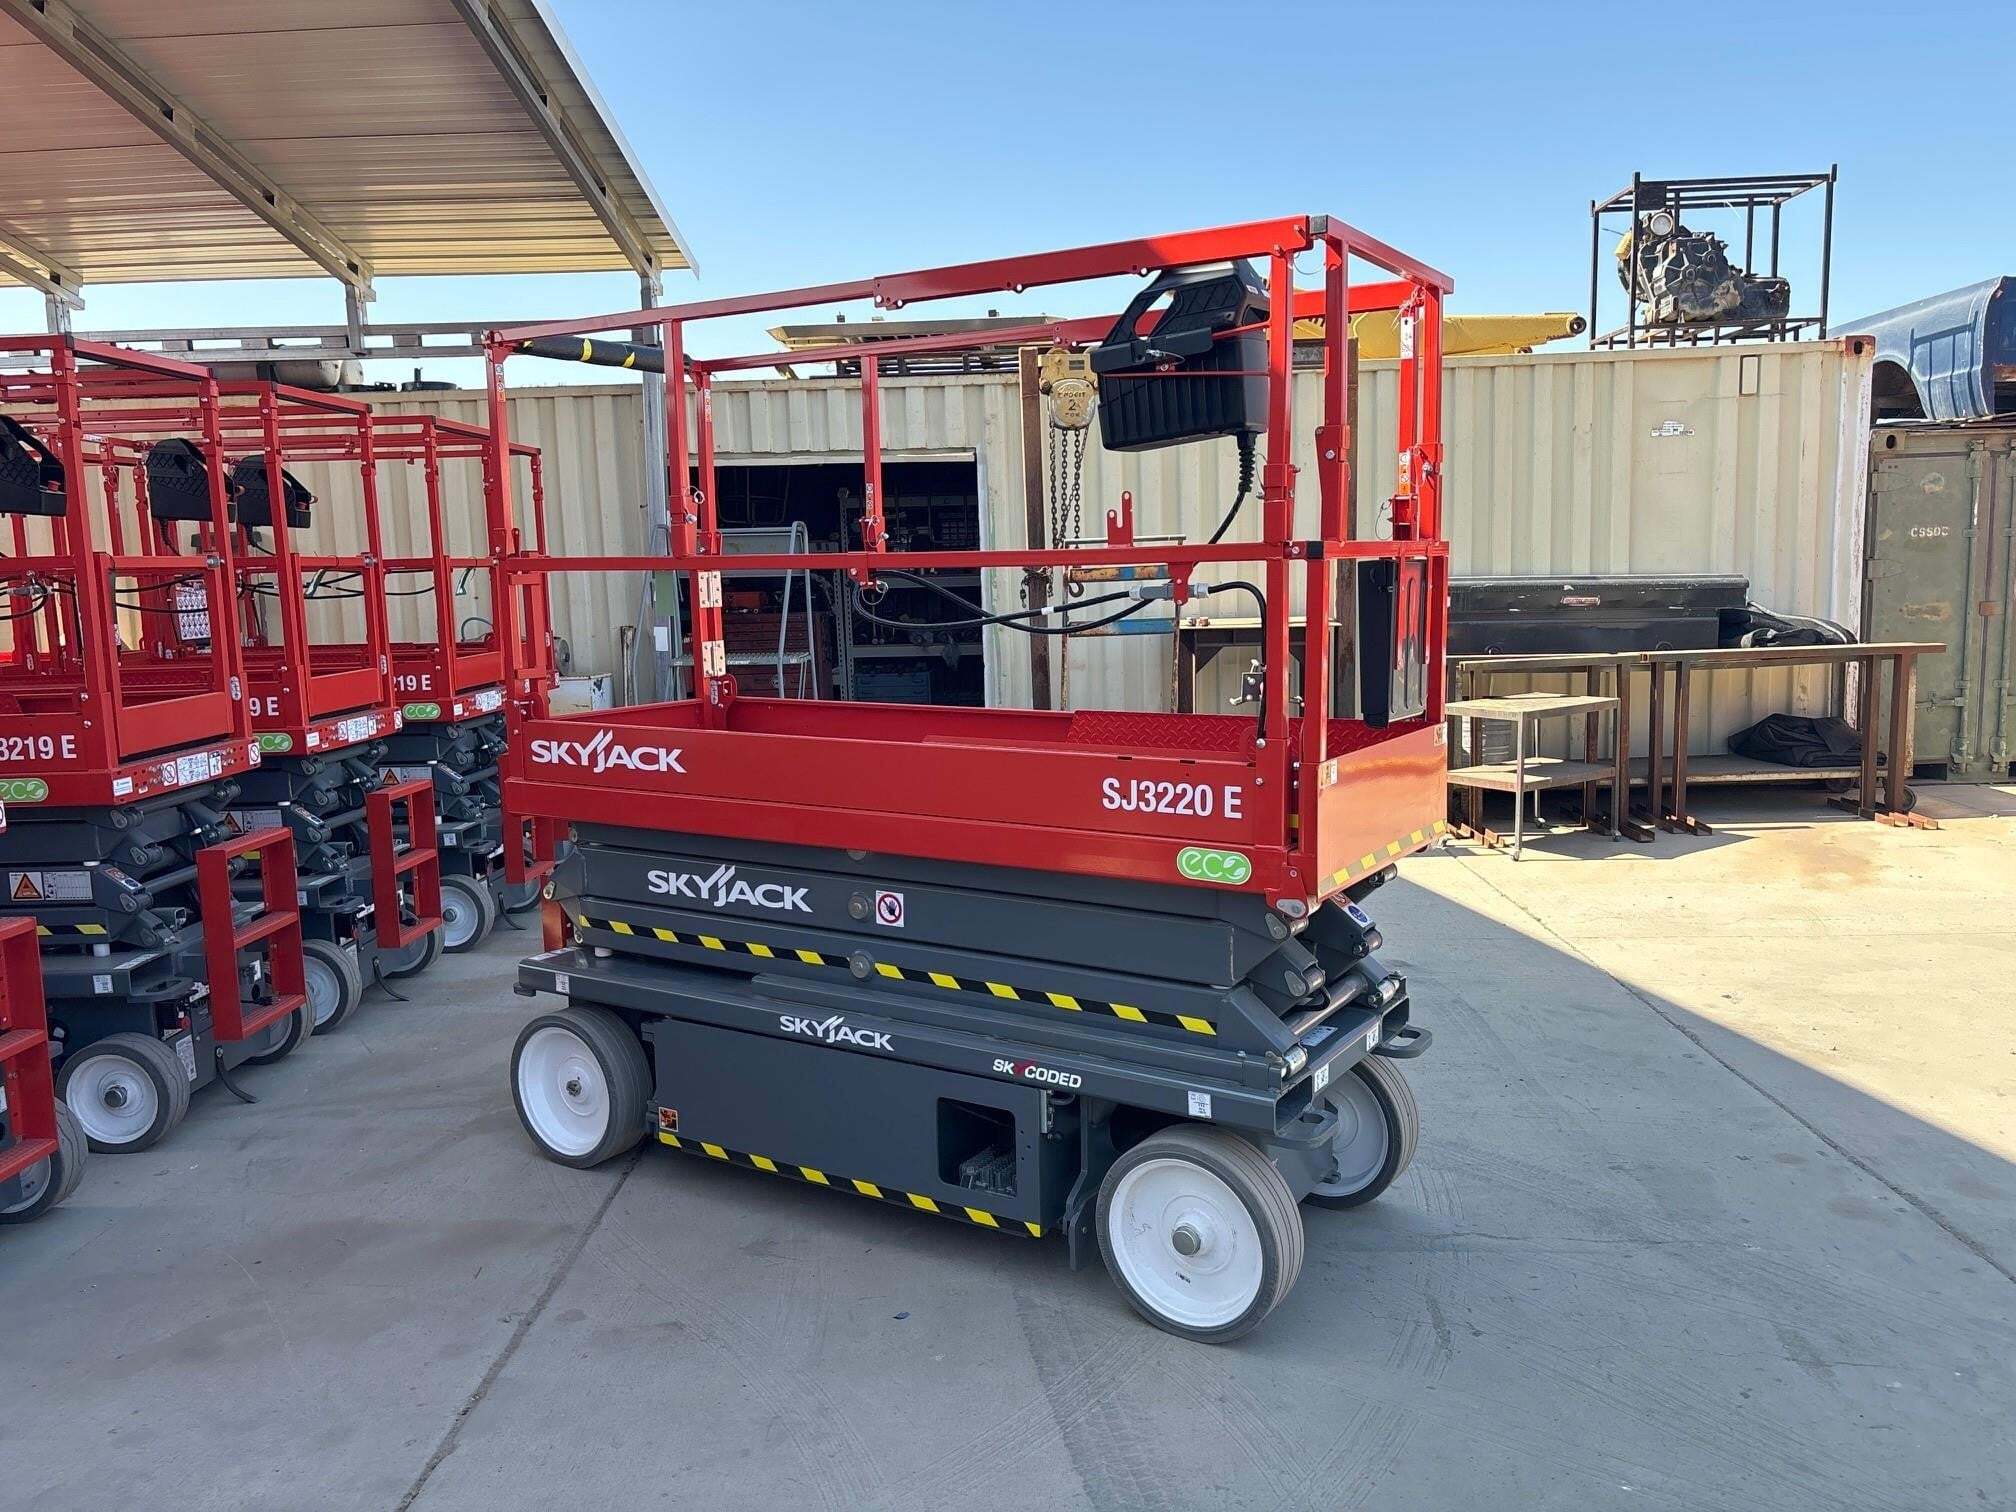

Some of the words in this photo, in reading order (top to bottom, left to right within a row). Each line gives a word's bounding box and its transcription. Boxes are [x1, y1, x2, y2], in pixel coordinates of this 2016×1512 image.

[1068, 399, 1077, 411] 2
[421, 674, 432, 691] E
[266, 696, 280, 716] E
[61, 734, 77, 759] E
[530, 729, 688, 774] SKYJACK
[1102, 777, 1214, 817] SJ3220
[1224, 785, 1243, 819] E
[1181, 851, 1247, 880] eco
[647, 864, 814, 913] SKYJACK
[779, 1015, 895, 1052] SKYJACK
